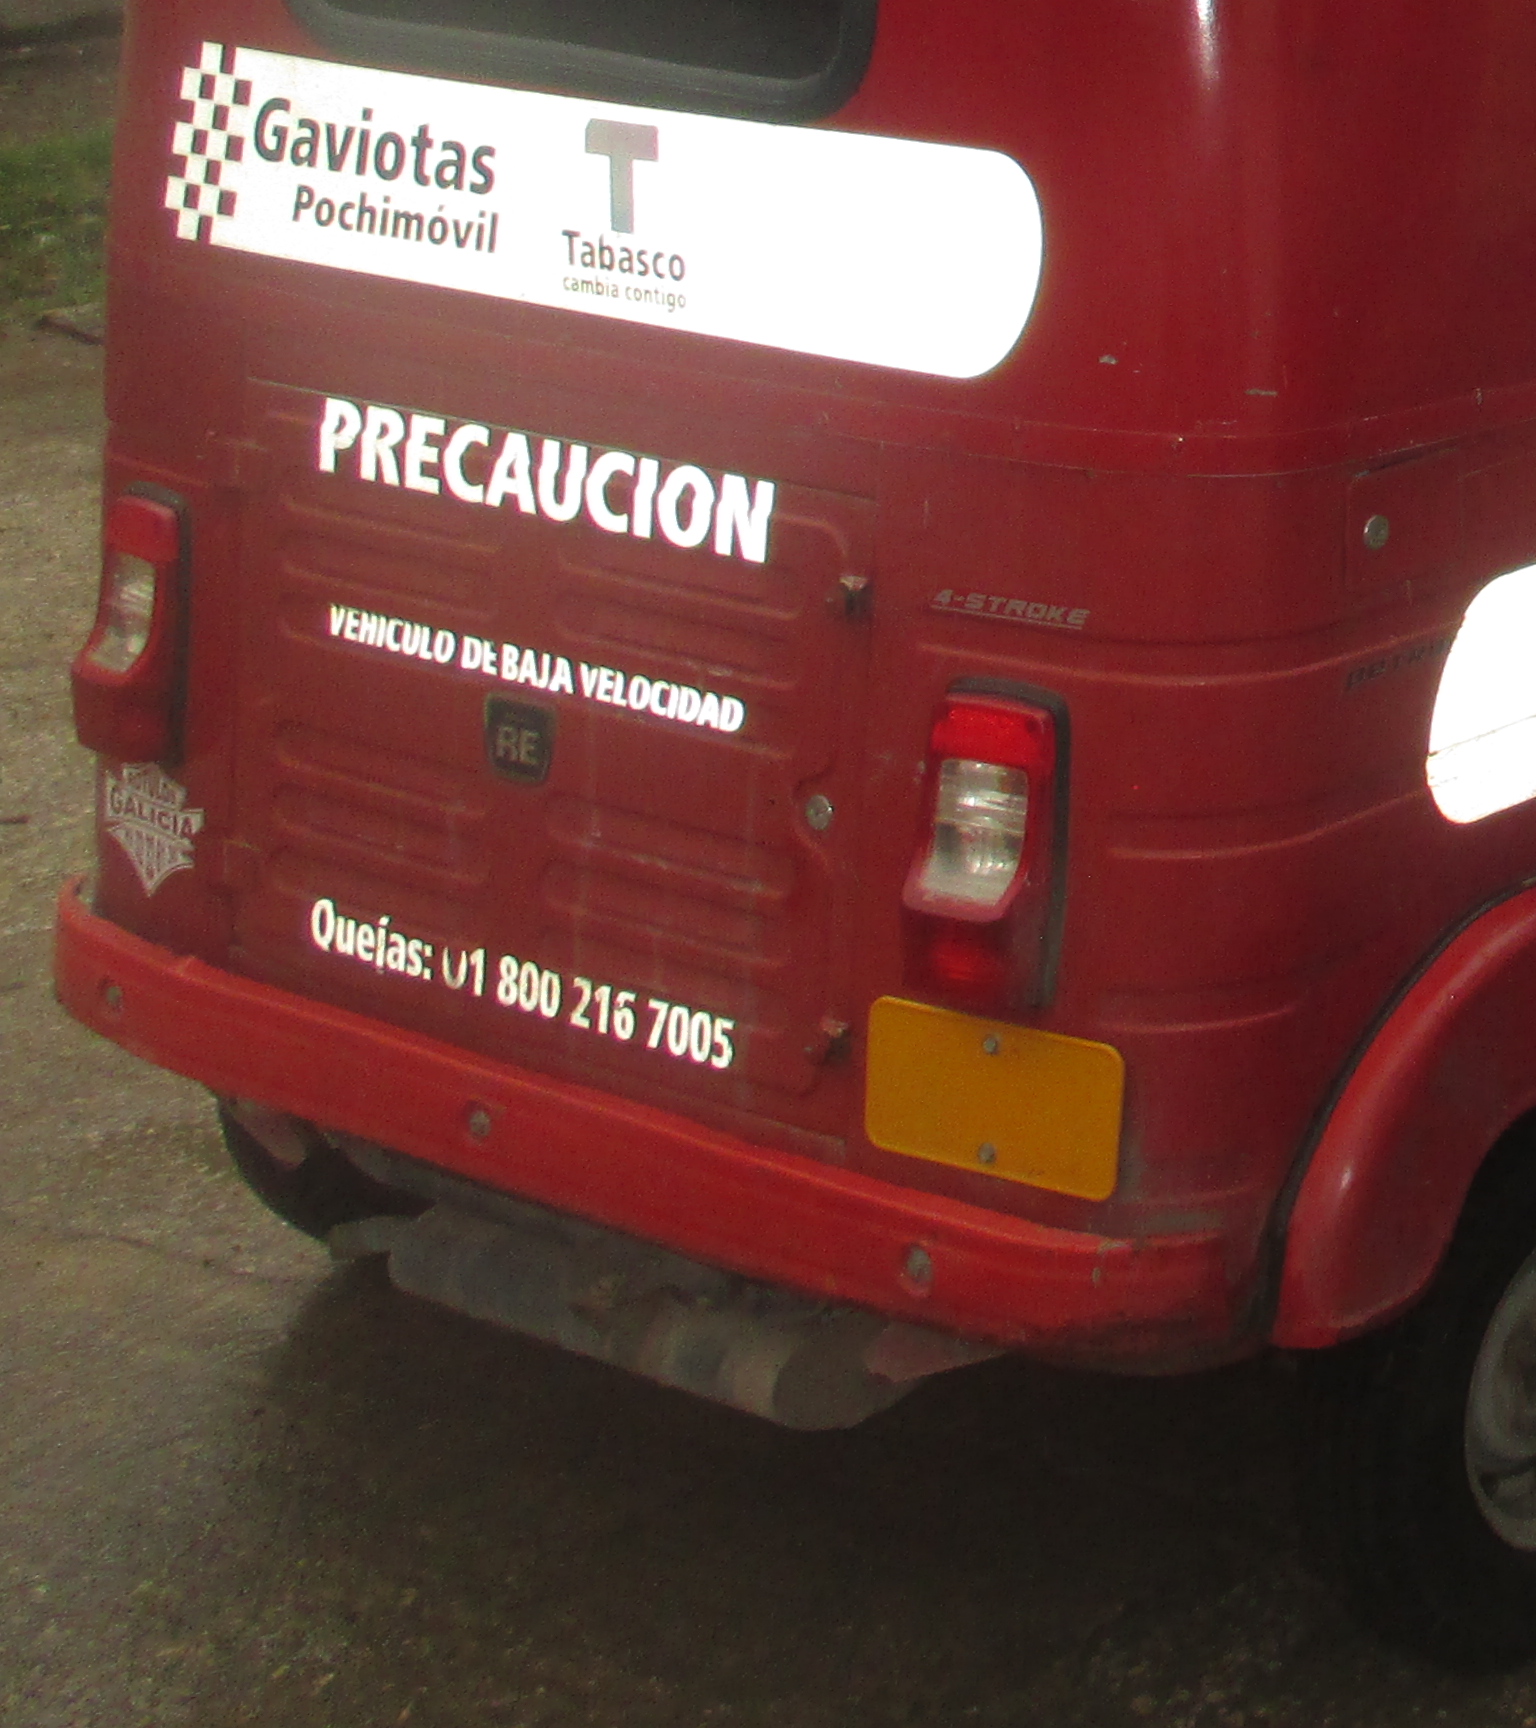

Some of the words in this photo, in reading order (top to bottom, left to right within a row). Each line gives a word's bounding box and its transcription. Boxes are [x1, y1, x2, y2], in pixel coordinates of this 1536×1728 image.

[253, 97, 498, 195] Gaviotas
[292, 184, 500, 254] Pochimóvil
[561, 228, 687, 282] Tabasco
[562, 274, 620, 300] cambia
[624, 282, 687, 313] contigo
[318, 396, 776, 564] PRECAUCION
[933, 589, 1091, 625] 4-STROKE
[328, 603, 456, 664] VEHICULO
[460, 635, 498, 675] DE
[501, 643, 573, 695] BAJA
[578, 661, 747, 733] VELOCIDAD
[494, 724, 539, 766] RE
[110, 783, 194, 840] GALICIA
[442, 945, 486, 996] 01
[497, 953, 562, 1019] 800
[570, 975, 637, 1041] 216
[647, 997, 736, 1069] 7005
